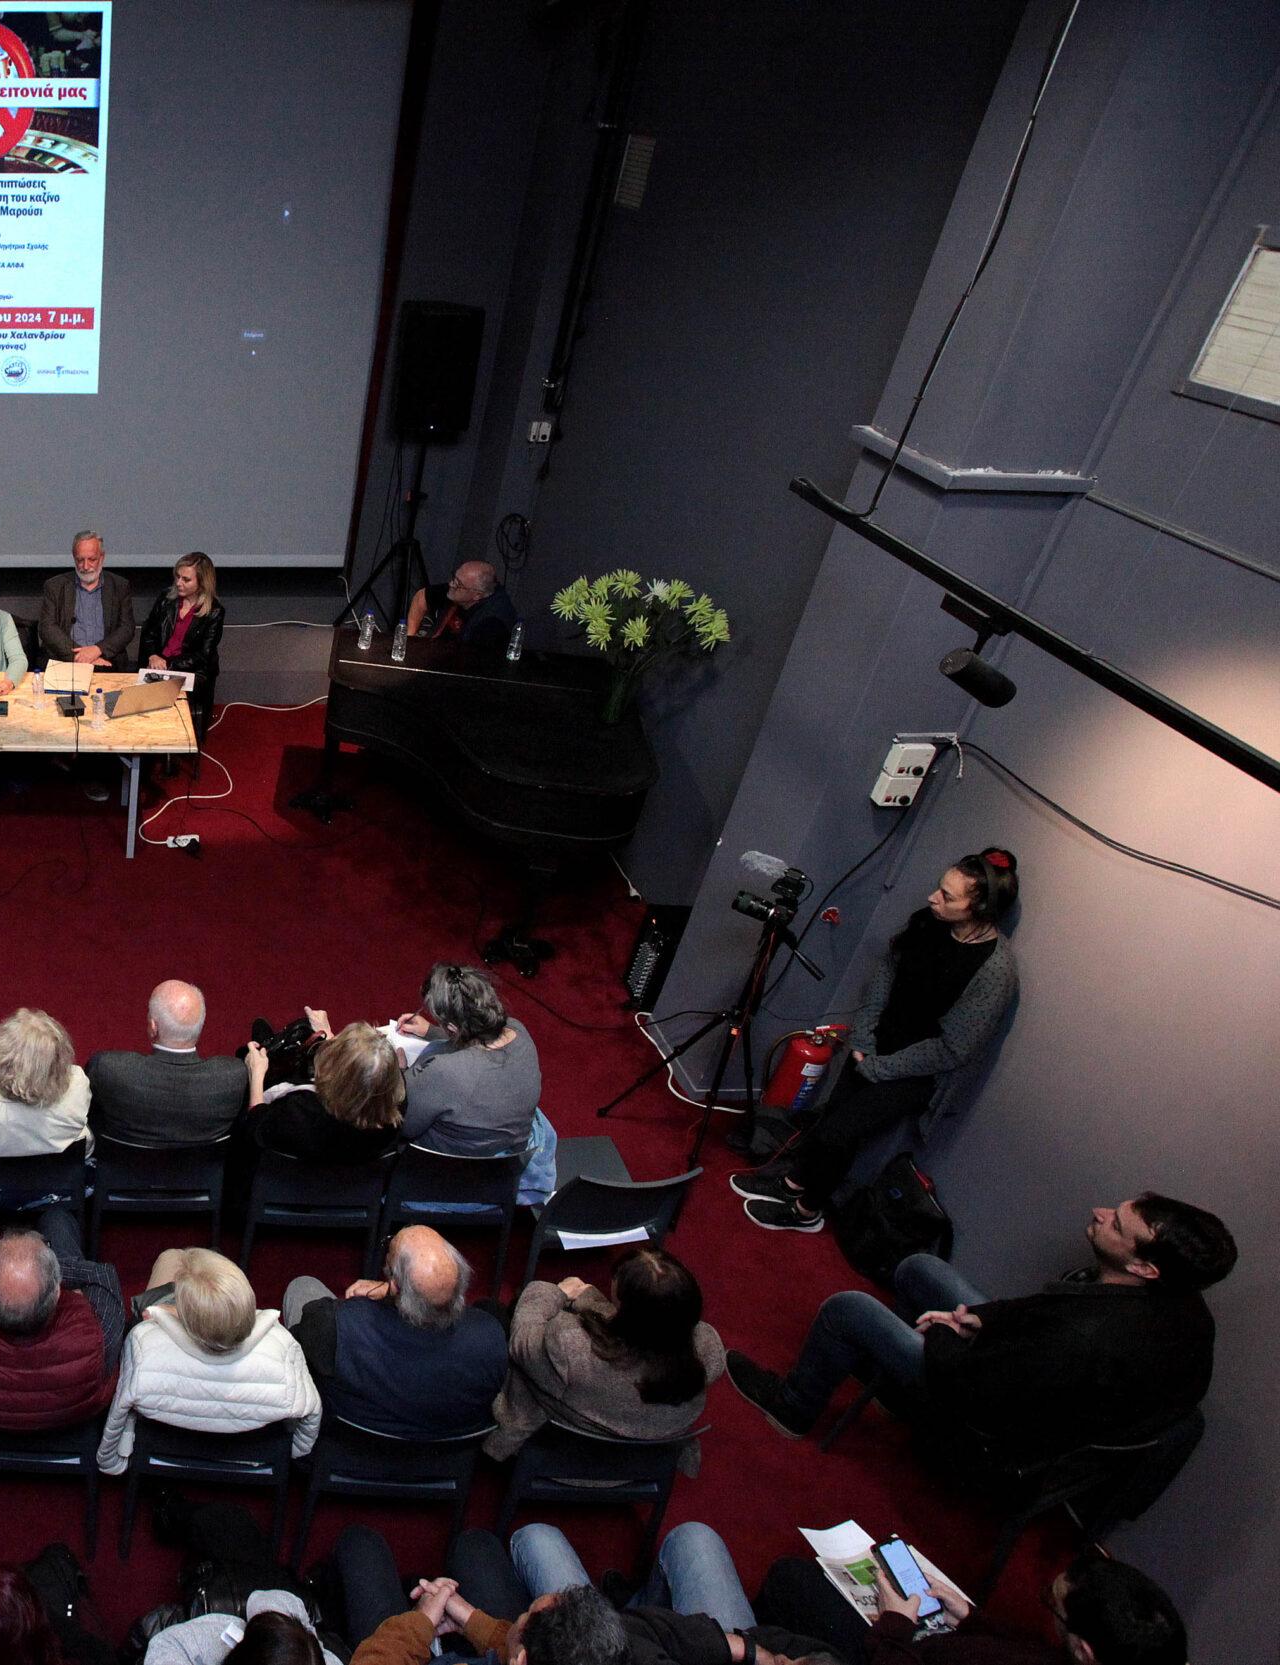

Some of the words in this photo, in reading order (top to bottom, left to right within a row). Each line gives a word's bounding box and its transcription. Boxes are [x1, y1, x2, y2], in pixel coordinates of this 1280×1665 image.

[58, 87, 87, 100] μας
[11, 194, 27, 202] του
[30, 192, 60, 204] καζίνο
[0, 205, 42, 218] Μαρούσι
[15, 313, 41, 322] 2024
[48, 311, 56, 322] 7
[60, 314, 85, 325] μ.μ.
[10, 331, 65, 341] Χαλανδρίου
